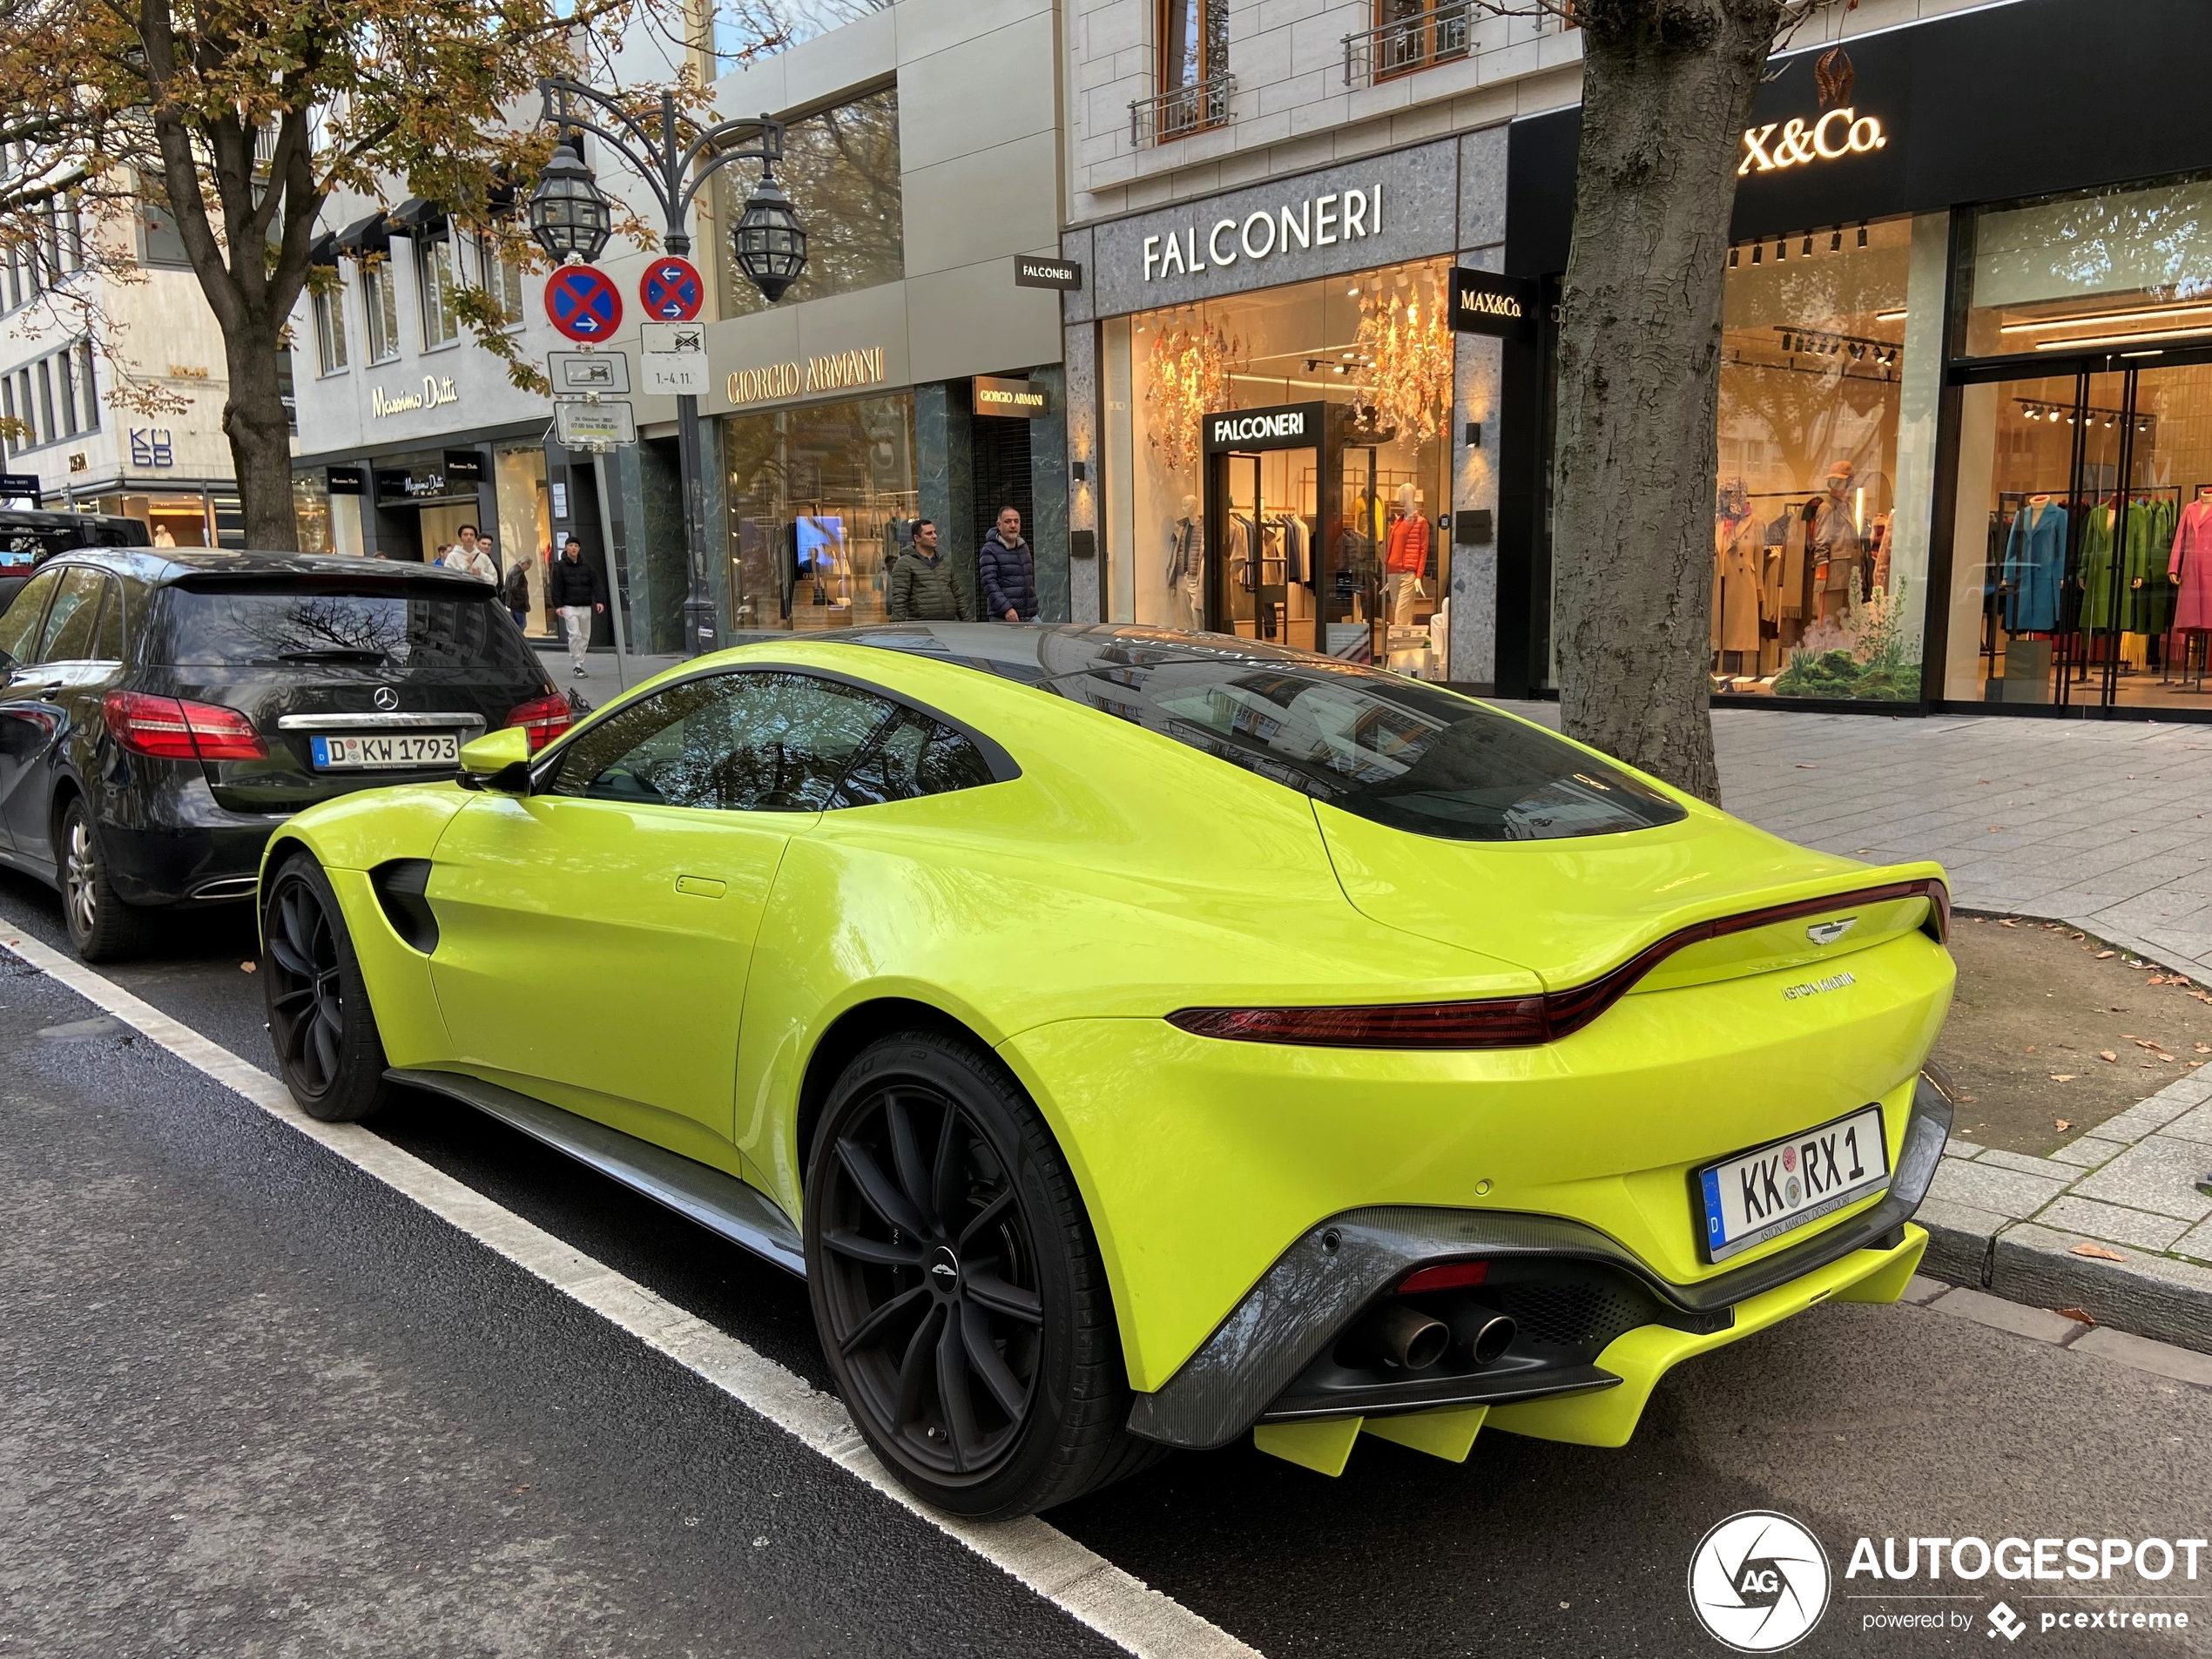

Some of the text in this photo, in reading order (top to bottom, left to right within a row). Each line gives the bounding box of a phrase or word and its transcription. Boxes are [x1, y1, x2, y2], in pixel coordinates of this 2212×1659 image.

[1143, 184, 1383, 281] FALCONERI
[1022, 264, 1073, 280] FALCONERI
[1460, 288, 1522, 318] MAX&Co.
[726, 346, 884, 405] GIORGIO ARMANI
[372, 374, 459, 418] Massimo Dutti
[980, 389, 1043, 406] GIORGIO ARMANI
[1214, 412, 1305, 442] FALCONERI
[329, 739, 456, 762] D KW 1793
[1781, 971, 1857, 1001] ASTON MARTIN
[1740, 1125, 1865, 1224] KK RX 1
[1710, 1216, 1719, 1234] D
[1759, 1224, 1784, 1242] ASTON
[1784, 1211, 1811, 1231] MARTIN
